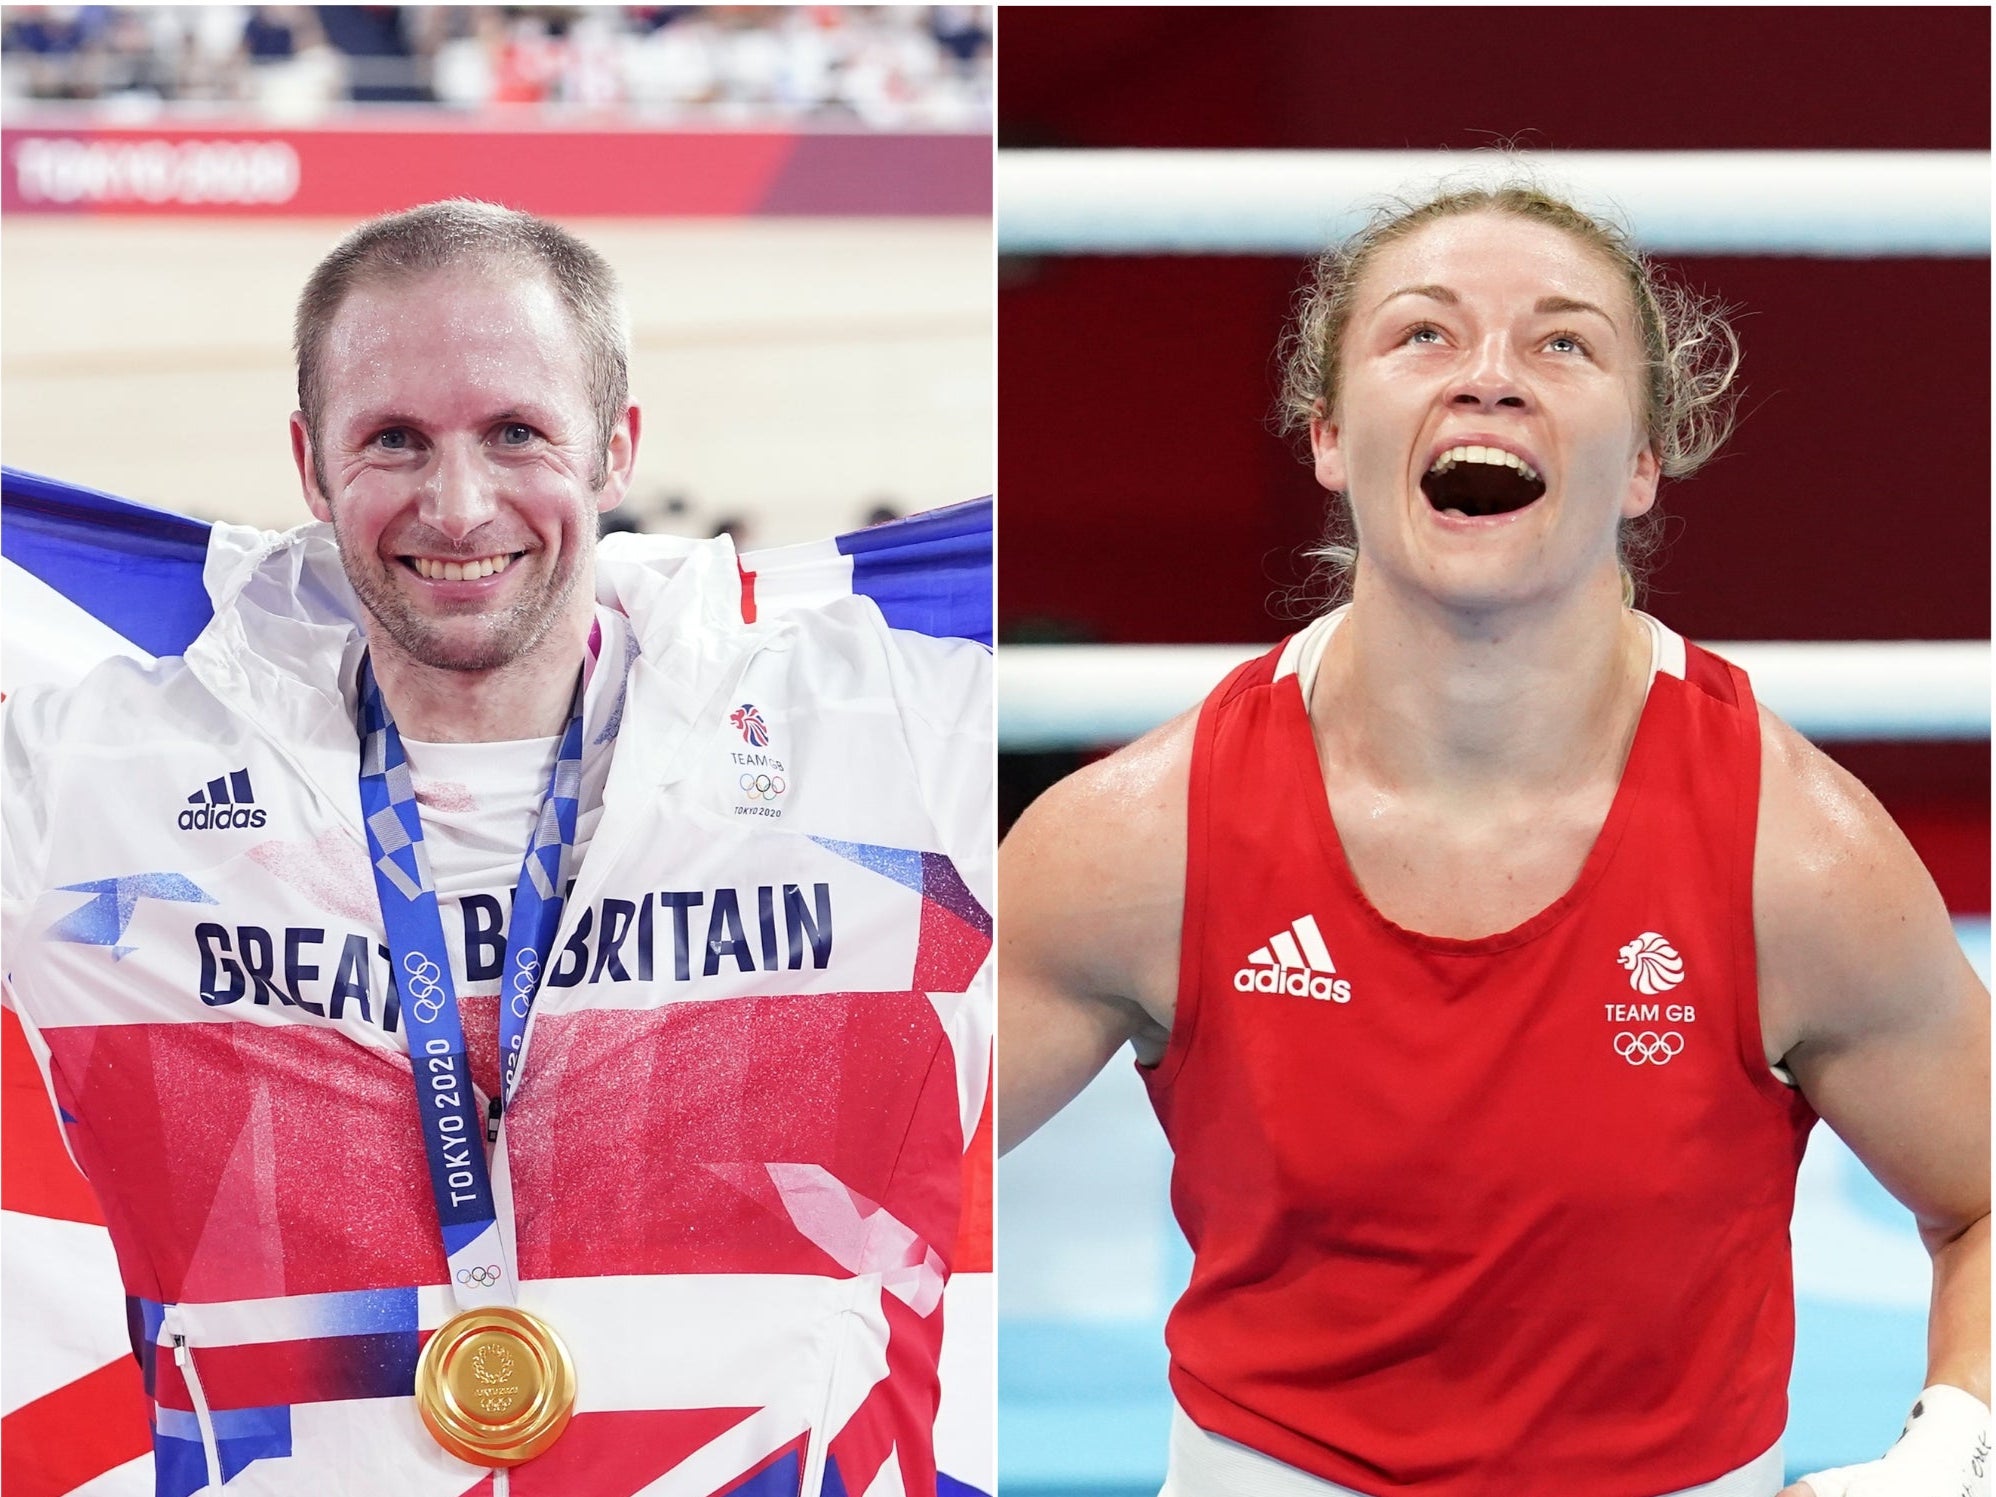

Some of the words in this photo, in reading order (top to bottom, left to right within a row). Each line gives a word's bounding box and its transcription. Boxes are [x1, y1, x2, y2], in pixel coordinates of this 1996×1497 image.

[730, 752, 768, 767] TEAM
[177, 802, 268, 831] adidas
[734, 806, 759, 816] TOKYO
[758, 806, 782, 818] 2020
[546, 882, 833, 988] BRITAIN
[1233, 962, 1352, 1004] adidas
[1604, 1003, 1660, 1022] TEAM
[1665, 1004, 1697, 1023] GB
[425, 1038, 461, 1109] 2020
[438, 1115, 477, 1208] TOKYO
